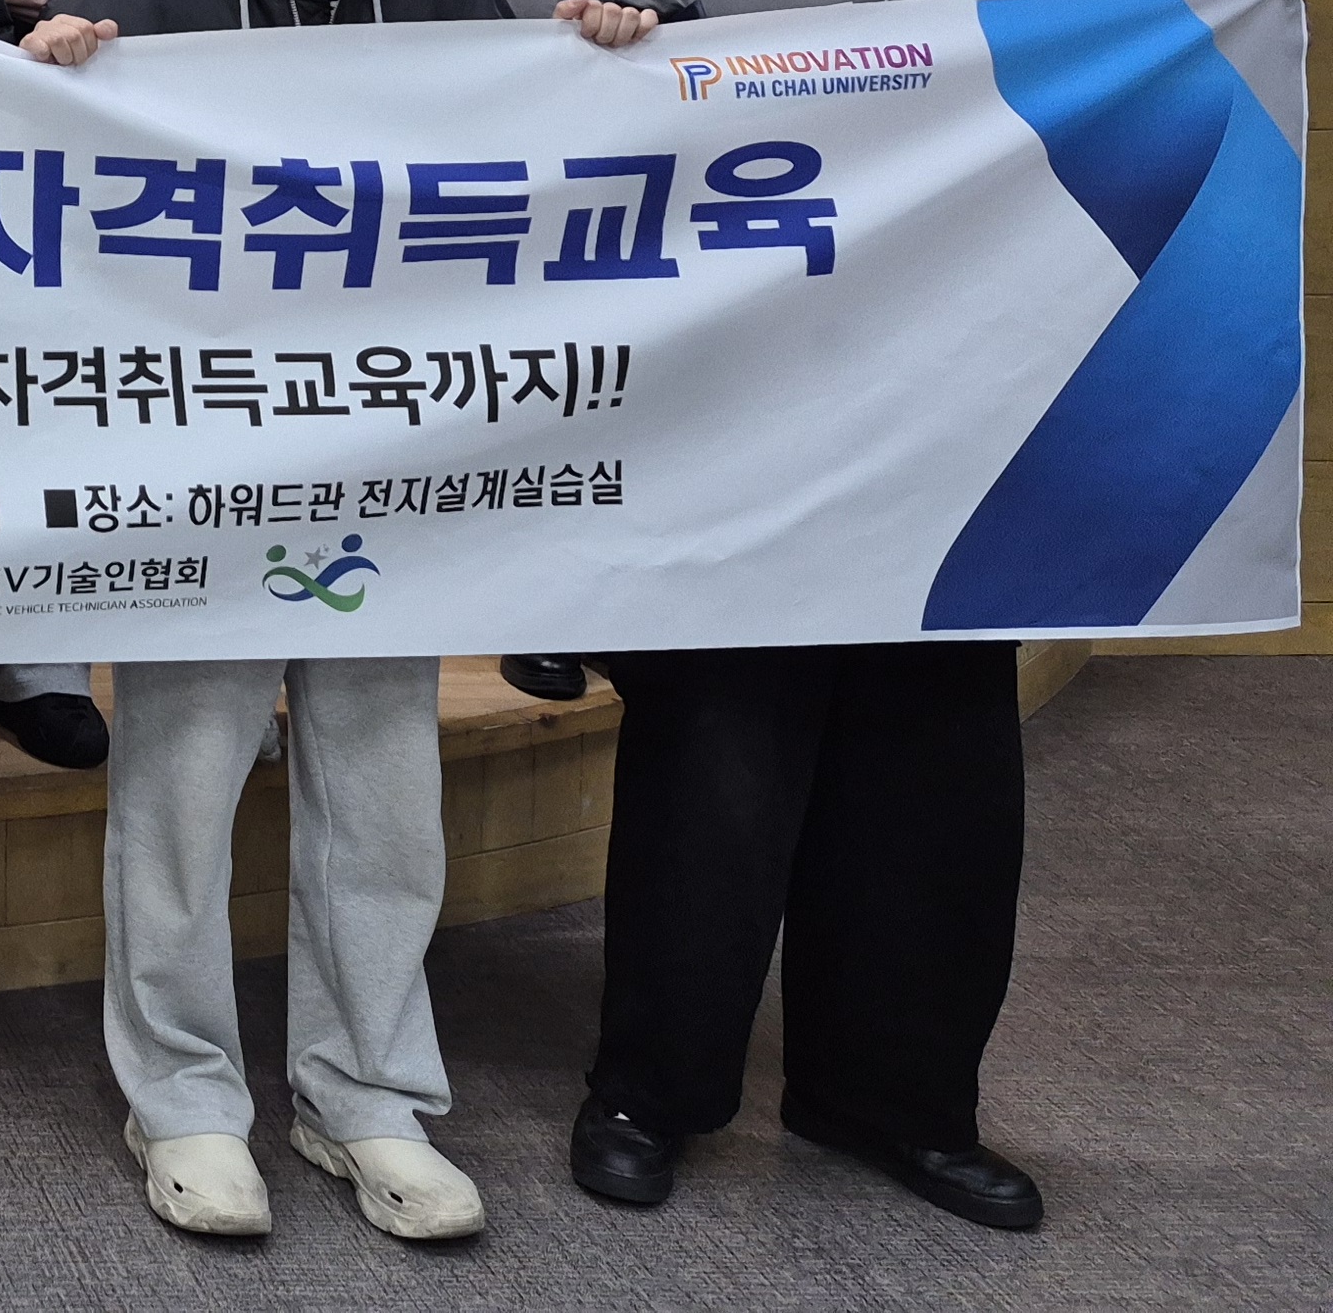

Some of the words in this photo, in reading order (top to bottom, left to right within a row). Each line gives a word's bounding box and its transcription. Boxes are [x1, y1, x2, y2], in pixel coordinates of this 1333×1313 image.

[726, 43, 933, 76] INNOVATION
[735, 81, 765, 98] PAI
[772, 79, 816, 96] CHAI
[823, 73, 931, 94] UNIVERSITY
[85, 485, 172, 533] 장소:
[189, 482, 345, 528] 하워드관
[358, 460, 622, 518] 전지설계실습실
[6, 603, 54, 614] VEHICLE
[58, 599, 126, 613] TECHNICIAN
[130, 596, 208, 609] ASSOCIATION
